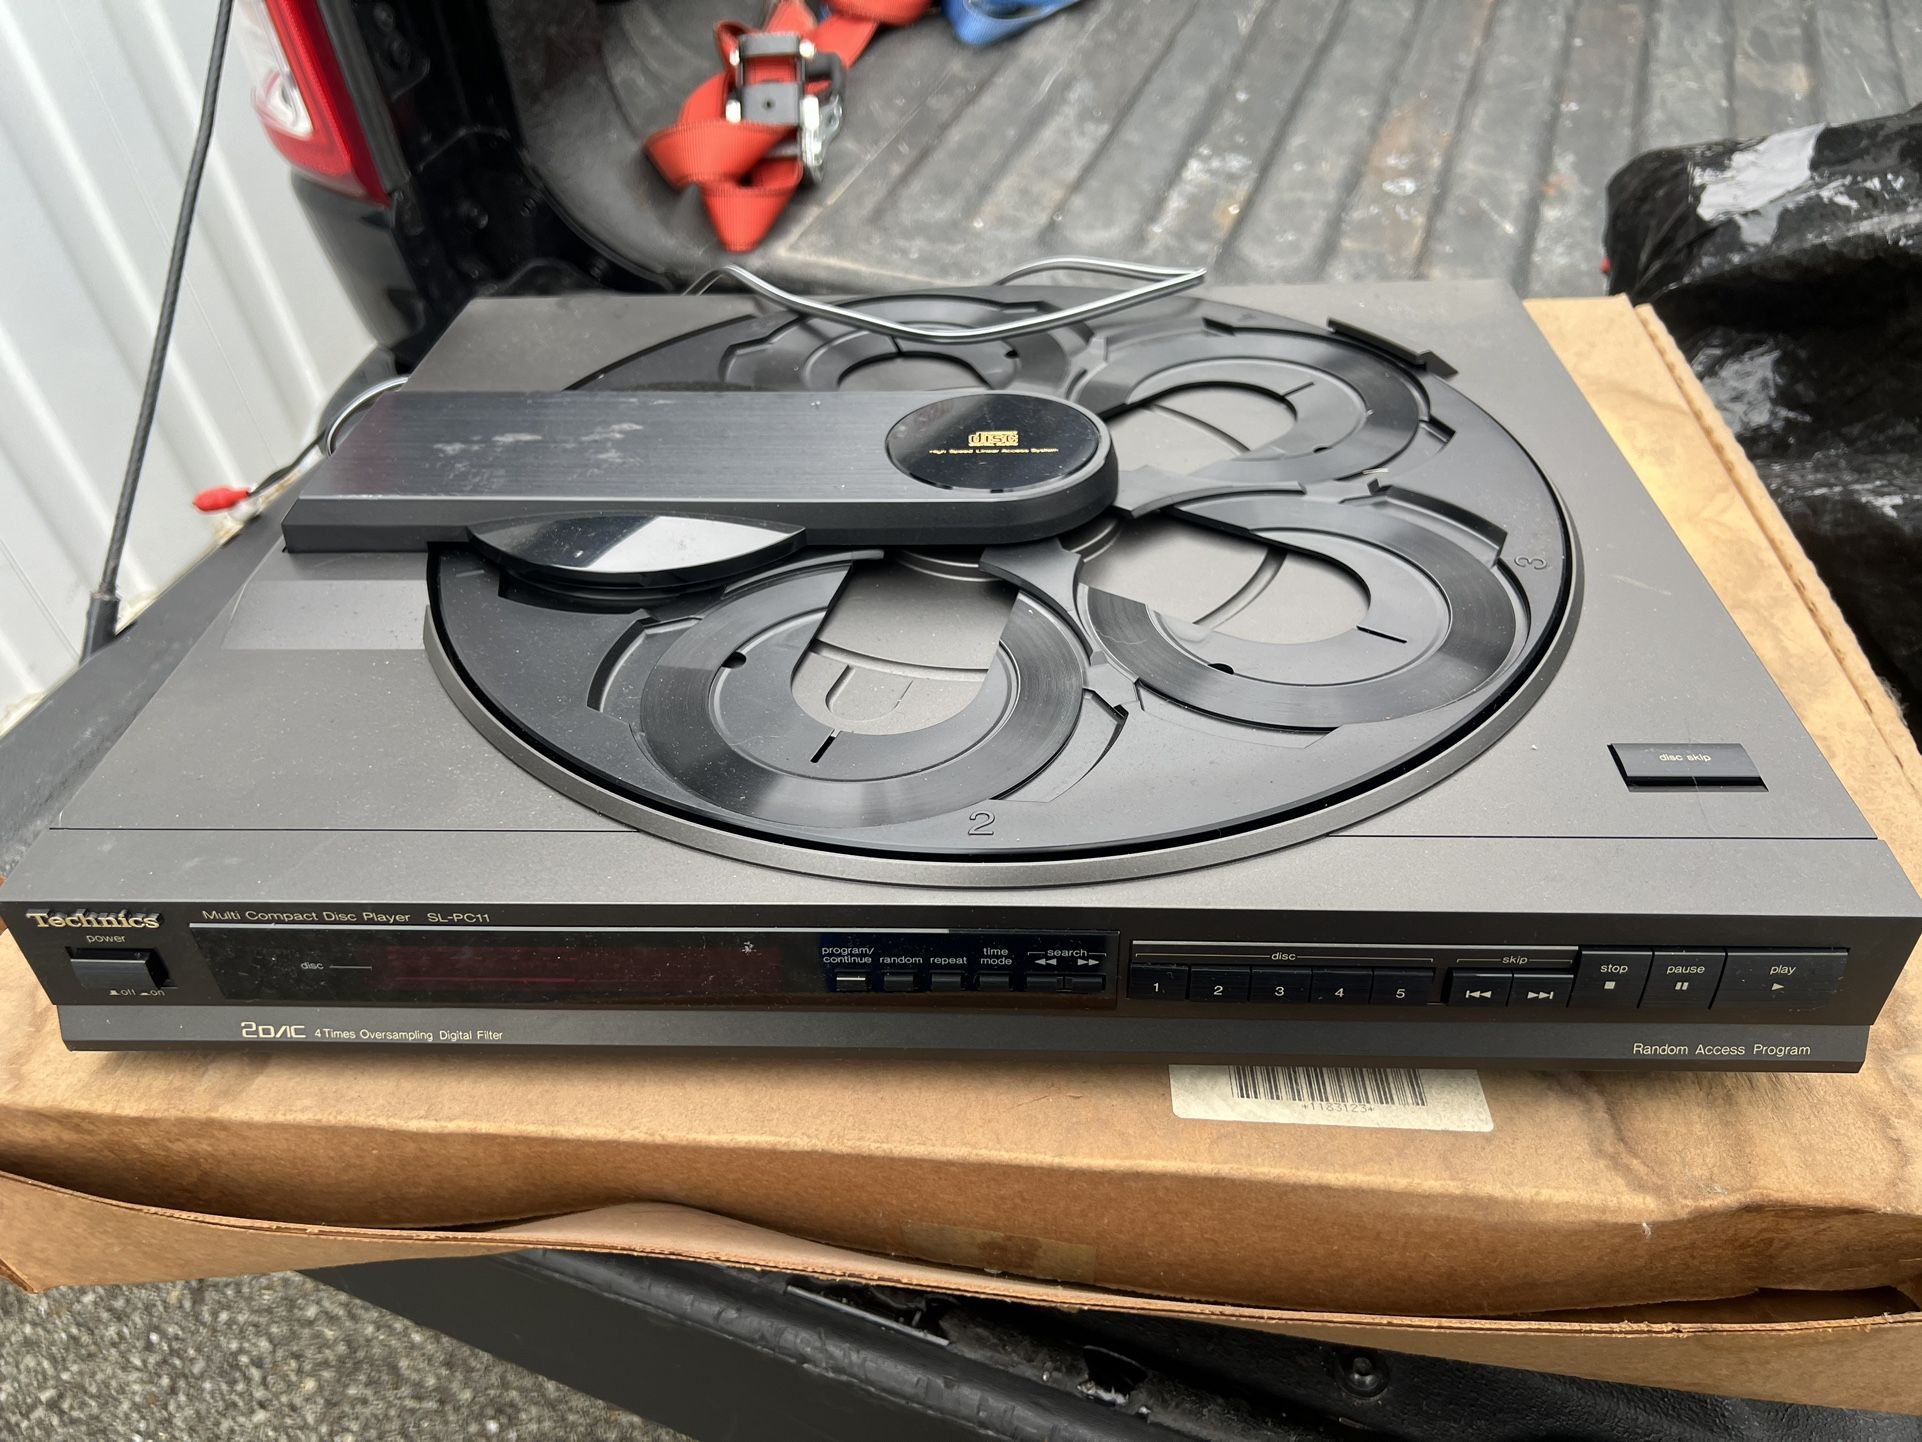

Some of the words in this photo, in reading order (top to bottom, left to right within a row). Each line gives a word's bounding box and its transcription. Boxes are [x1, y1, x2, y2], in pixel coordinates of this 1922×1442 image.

[968, 431, 1018, 447] disc
[1659, 753, 1683, 761] disc
[1686, 753, 1711, 762] skip
[968, 810, 995, 836] 2
[25, 908, 163, 929] Technics
[202, 910, 241, 921] Multi
[245, 910, 319, 922] Compact
[322, 911, 357, 922] Disc
[363, 911, 411, 924] Player
[427, 912, 490, 924] SL-PC11
[86, 933, 127, 943] power
[821, 945, 875, 955] program/
[983, 946, 1009, 956] time
[1047, 947, 1088, 957] search
[823, 955, 872, 964] continue
[879, 955, 923, 965] random
[930, 956, 967, 966] repeat
[980, 956, 1013, 965] mode
[1271, 951, 1296, 961] disc
[1502, 954, 1528, 966] skip
[301, 961, 324, 970] disc
[1599, 962, 1628, 975] stop
[1666, 964, 1705, 976] pause
[1769, 963, 1796, 977] play
[1152, 982, 1161, 993] 1
[1213, 985, 1223, 997] 2
[1274, 986, 1285, 997] 3
[1334, 987, 1345, 998] 4
[1395, 988, 1406, 999] 5
[314, 1028, 322, 1038] 4
[322, 1028, 356, 1039] Times
[359, 1028, 434, 1042] Oversampling
[439, 1030, 473, 1042] Digital
[477, 1030, 504, 1040] Filter
[1632, 1042, 1689, 1055] Random
[1695, 1043, 1746, 1056] Access
[1753, 1043, 1812, 1058] Program
